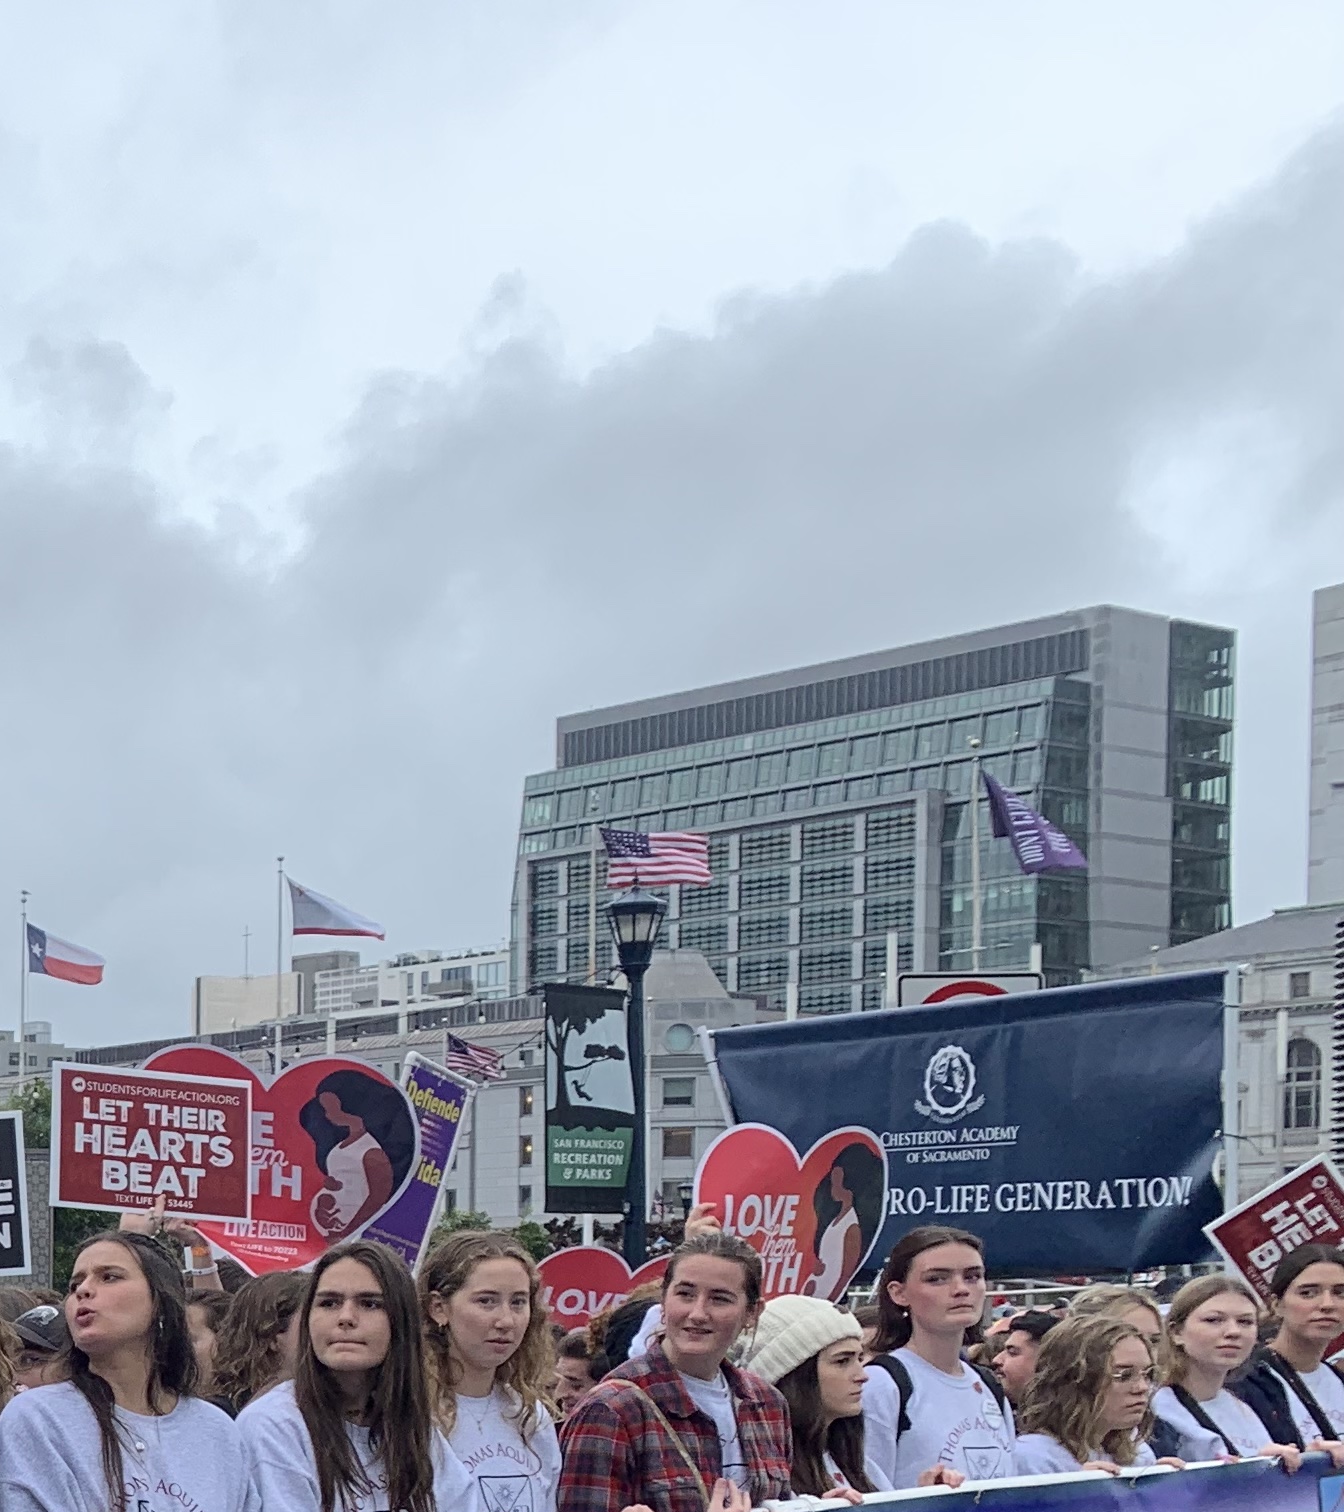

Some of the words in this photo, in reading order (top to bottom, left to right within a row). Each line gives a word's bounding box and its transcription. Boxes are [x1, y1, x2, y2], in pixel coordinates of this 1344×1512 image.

[85, 1080, 241, 1106] STUDENTSFORLIFEACTION.ORG
[82, 1096, 134, 1123] LET
[143, 1102, 227, 1133] THEIR
[73, 1121, 235, 1168] HEARTS
[553, 1138, 573, 1149] SAN
[574, 1138, 625, 1150] FRANCISCO
[960, 1124, 1021, 1144] ACADEMY
[250, 1147, 289, 1166] em
[553, 1152, 625, 1166] RECREATION
[921, 1148, 991, 1163] SACRAMENTO
[101, 1159, 207, 1199] BEAT
[250, 1163, 302, 1202] TH
[417, 1156, 442, 1187] ida
[562, 1167, 573, 1181] &
[575, 1168, 613, 1181] PARKS
[135, 1195, 153, 1206] LIFE
[167, 1198, 194, 1209] 53445
[886, 1184, 991, 1216] RO-LIFE
[995, 1175, 1192, 1213] GENERATION!
[723, 1193, 800, 1238] LOVE
[1295, 1191, 1340, 1236] LET
[260, 1222, 305, 1239] ACTION
[761, 1251, 802, 1295] TH
[463, 1443, 494, 1475] OMAS
